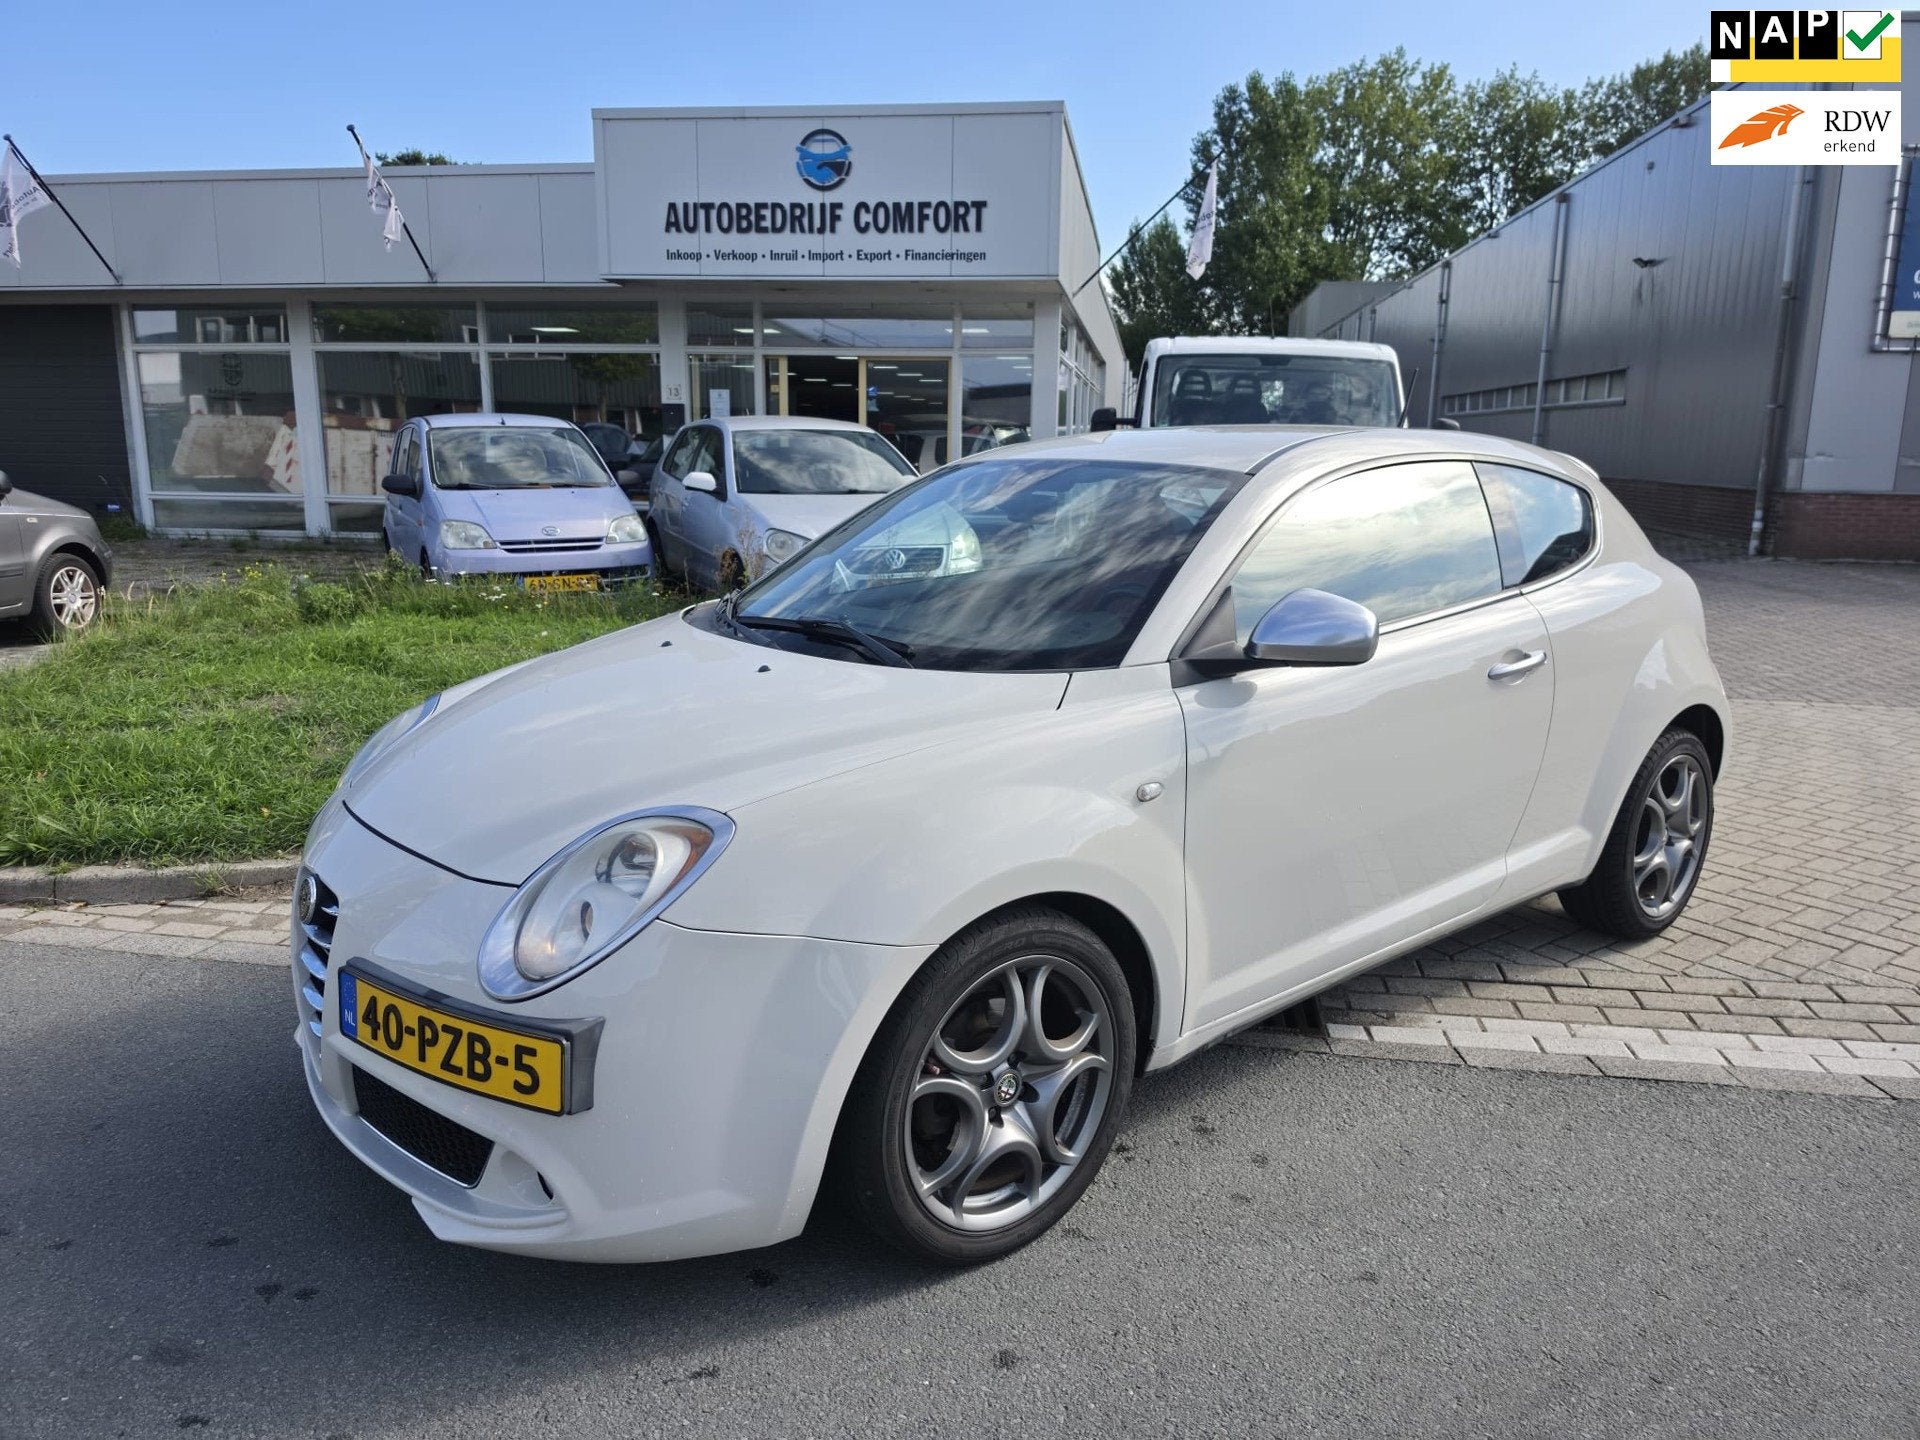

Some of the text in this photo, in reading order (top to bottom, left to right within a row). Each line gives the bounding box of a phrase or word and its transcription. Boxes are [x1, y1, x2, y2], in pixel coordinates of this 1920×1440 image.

[665, 200, 988, 234] AUTOBEDRIJF COMFORT
[666, 249, 987, 262] Inkoop Verkoop Inruil Import Export Financieringen
[668, 387, 681, 397] 13
[344, 1008, 356, 1027] NL
[362, 995, 540, 1096] 40-PZB-5
